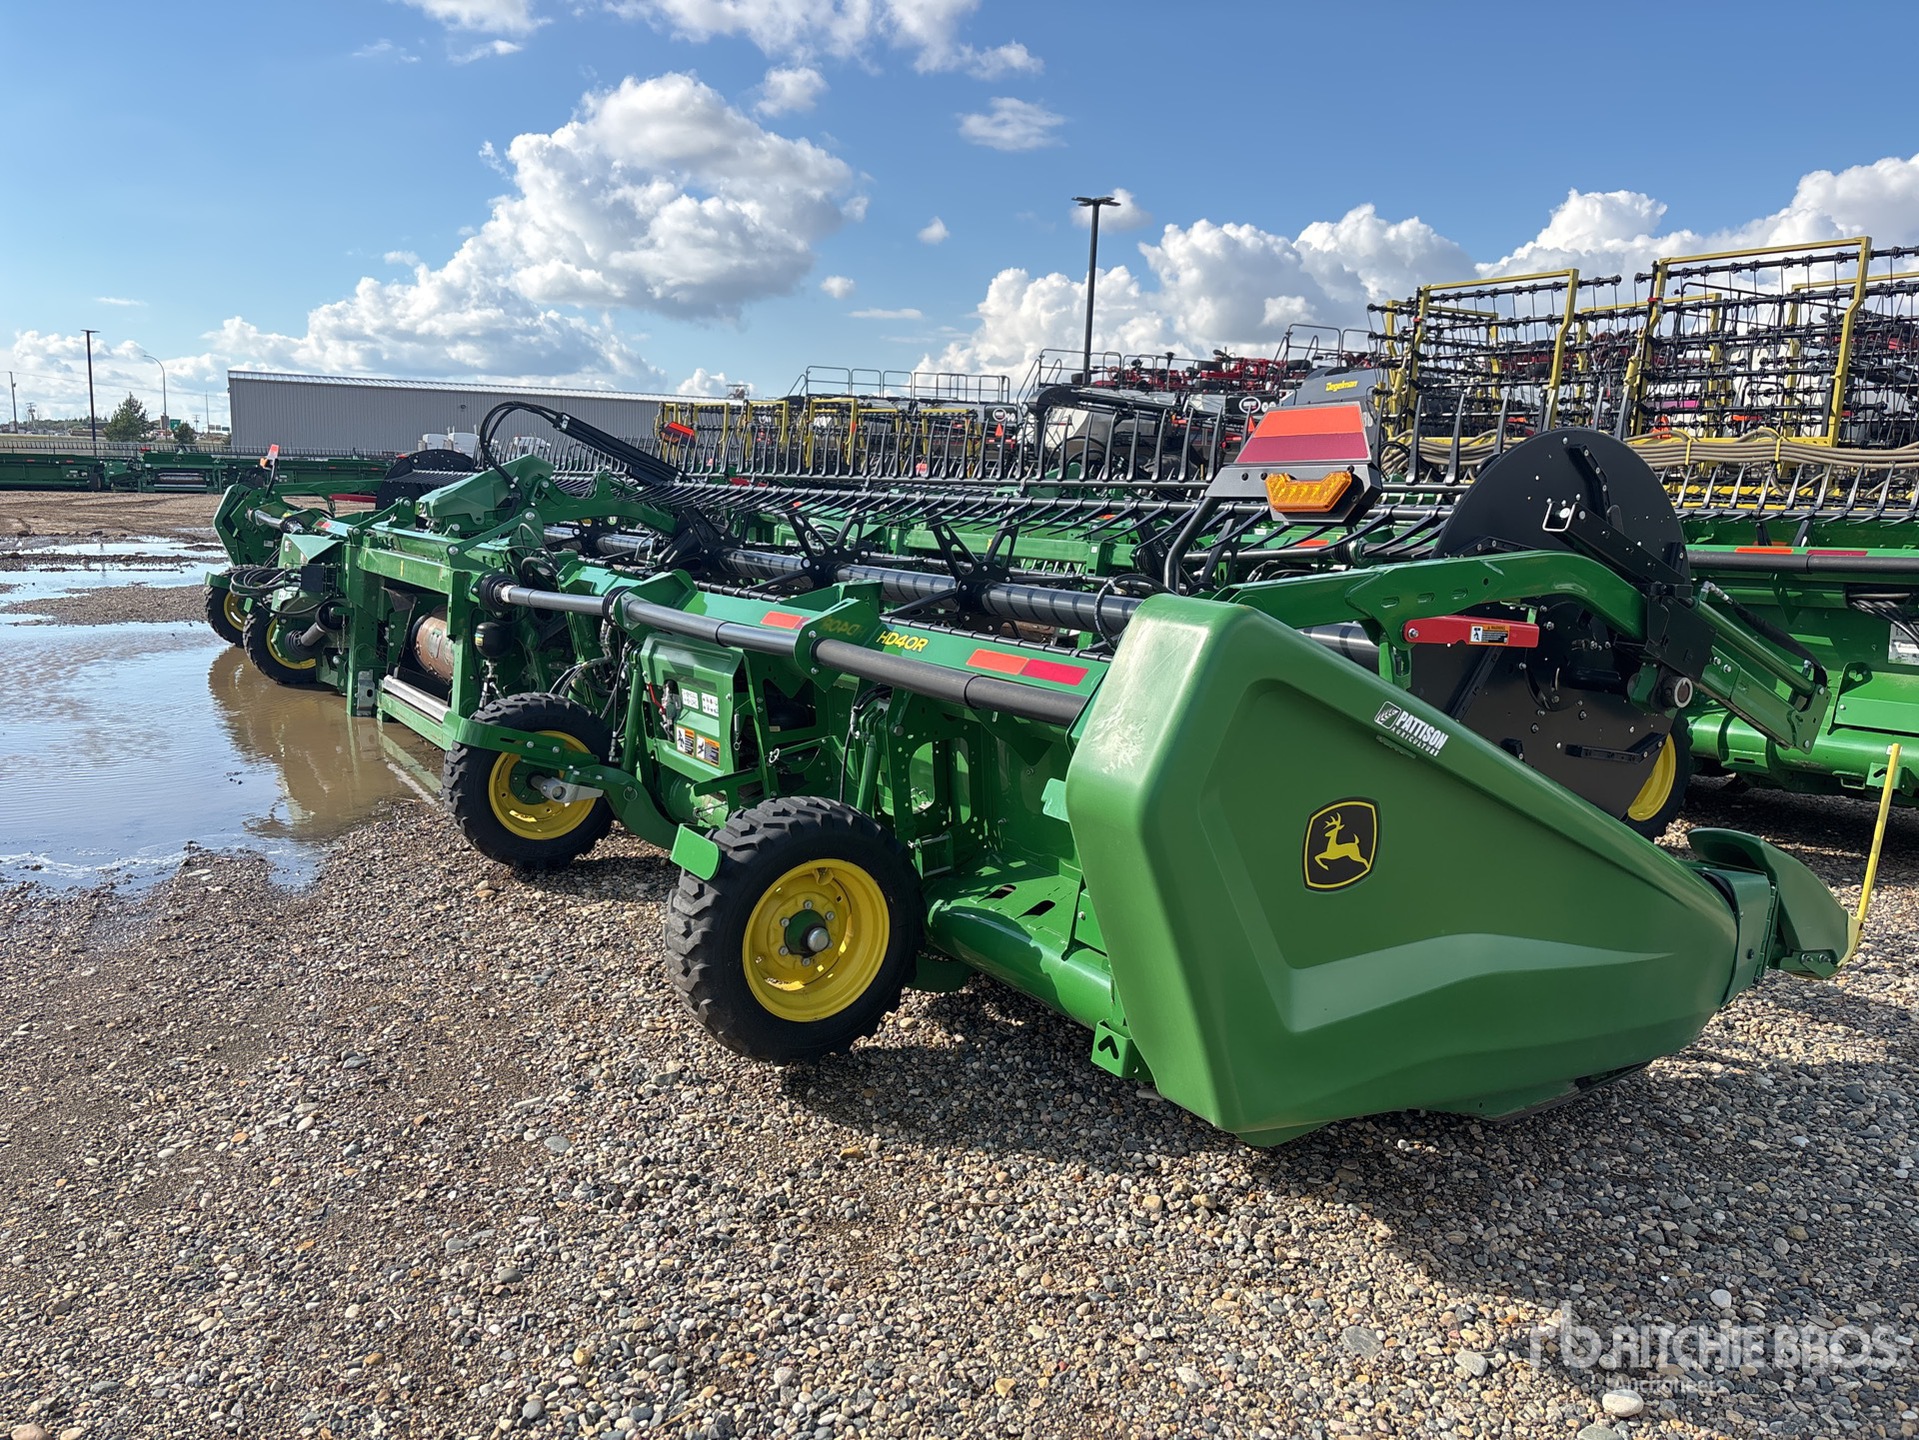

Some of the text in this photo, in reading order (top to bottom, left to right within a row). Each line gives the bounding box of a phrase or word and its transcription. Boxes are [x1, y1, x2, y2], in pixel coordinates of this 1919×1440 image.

[1325, 380, 1358, 392] Degelman
[876, 631, 929, 652] HD40R
[1391, 727, 1440, 757] AGRICULTURE
[1396, 711, 1449, 749] PATTISON
